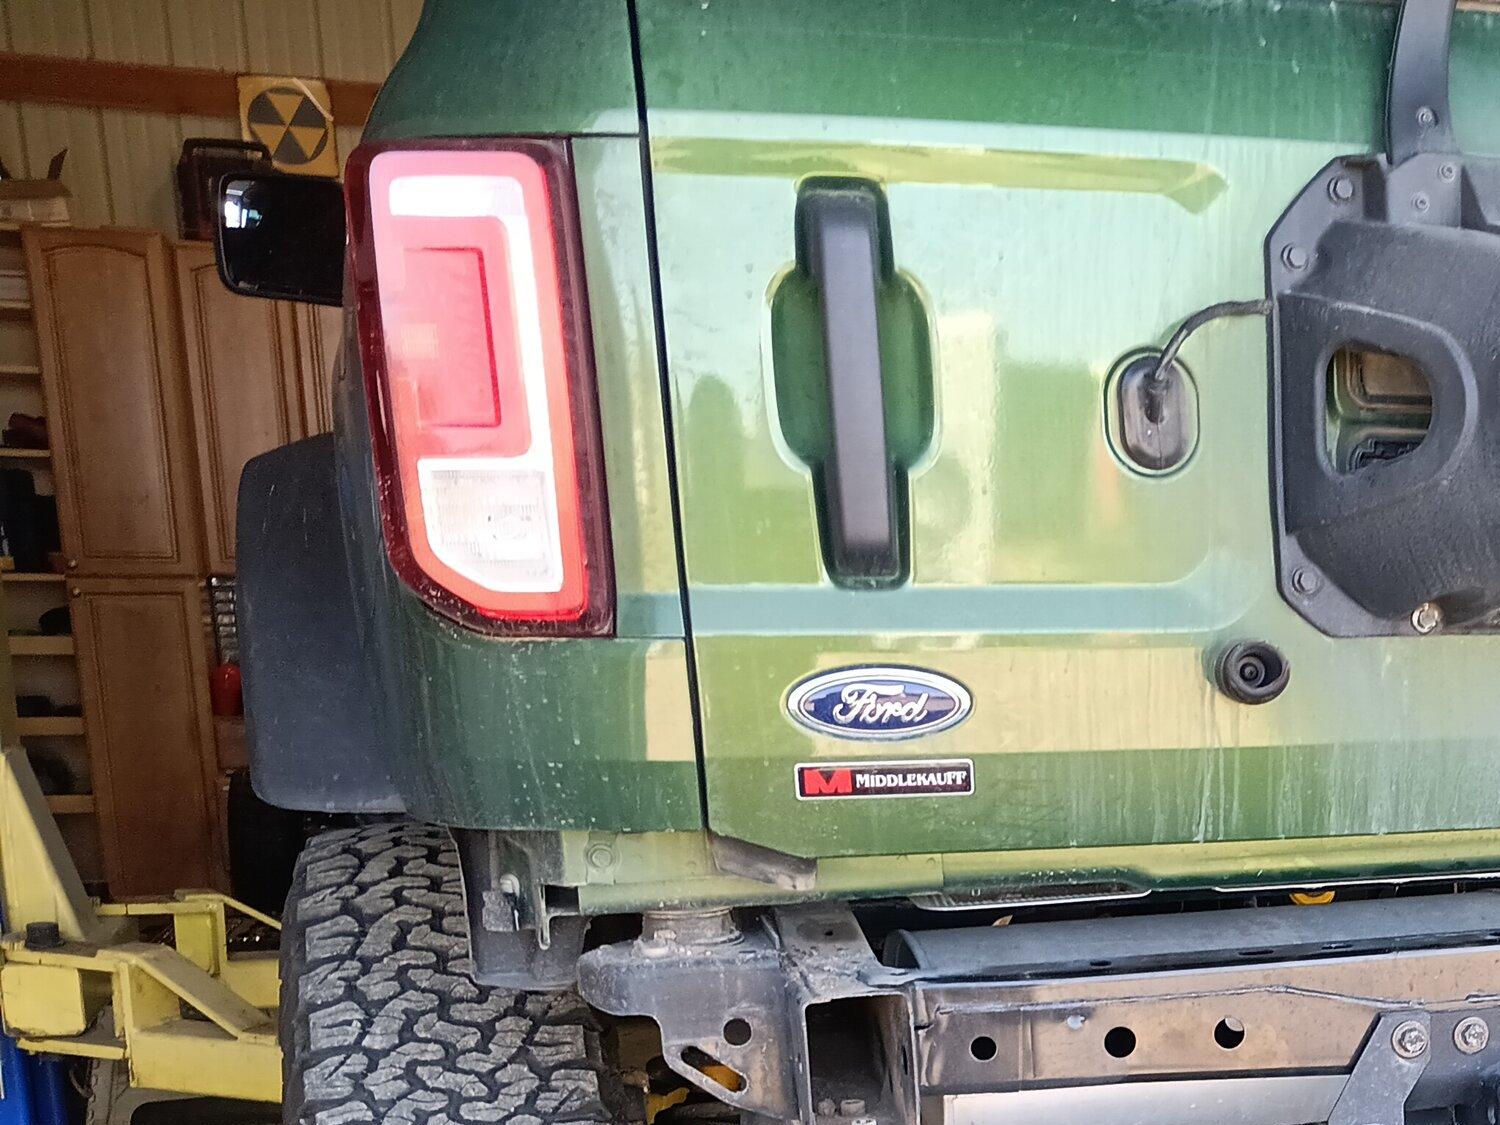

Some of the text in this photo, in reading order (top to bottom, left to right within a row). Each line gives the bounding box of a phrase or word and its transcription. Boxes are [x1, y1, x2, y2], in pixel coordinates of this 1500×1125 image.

[833, 684, 929, 724] Ford
[804, 768, 968, 795] M MIDDLEKAUFF
